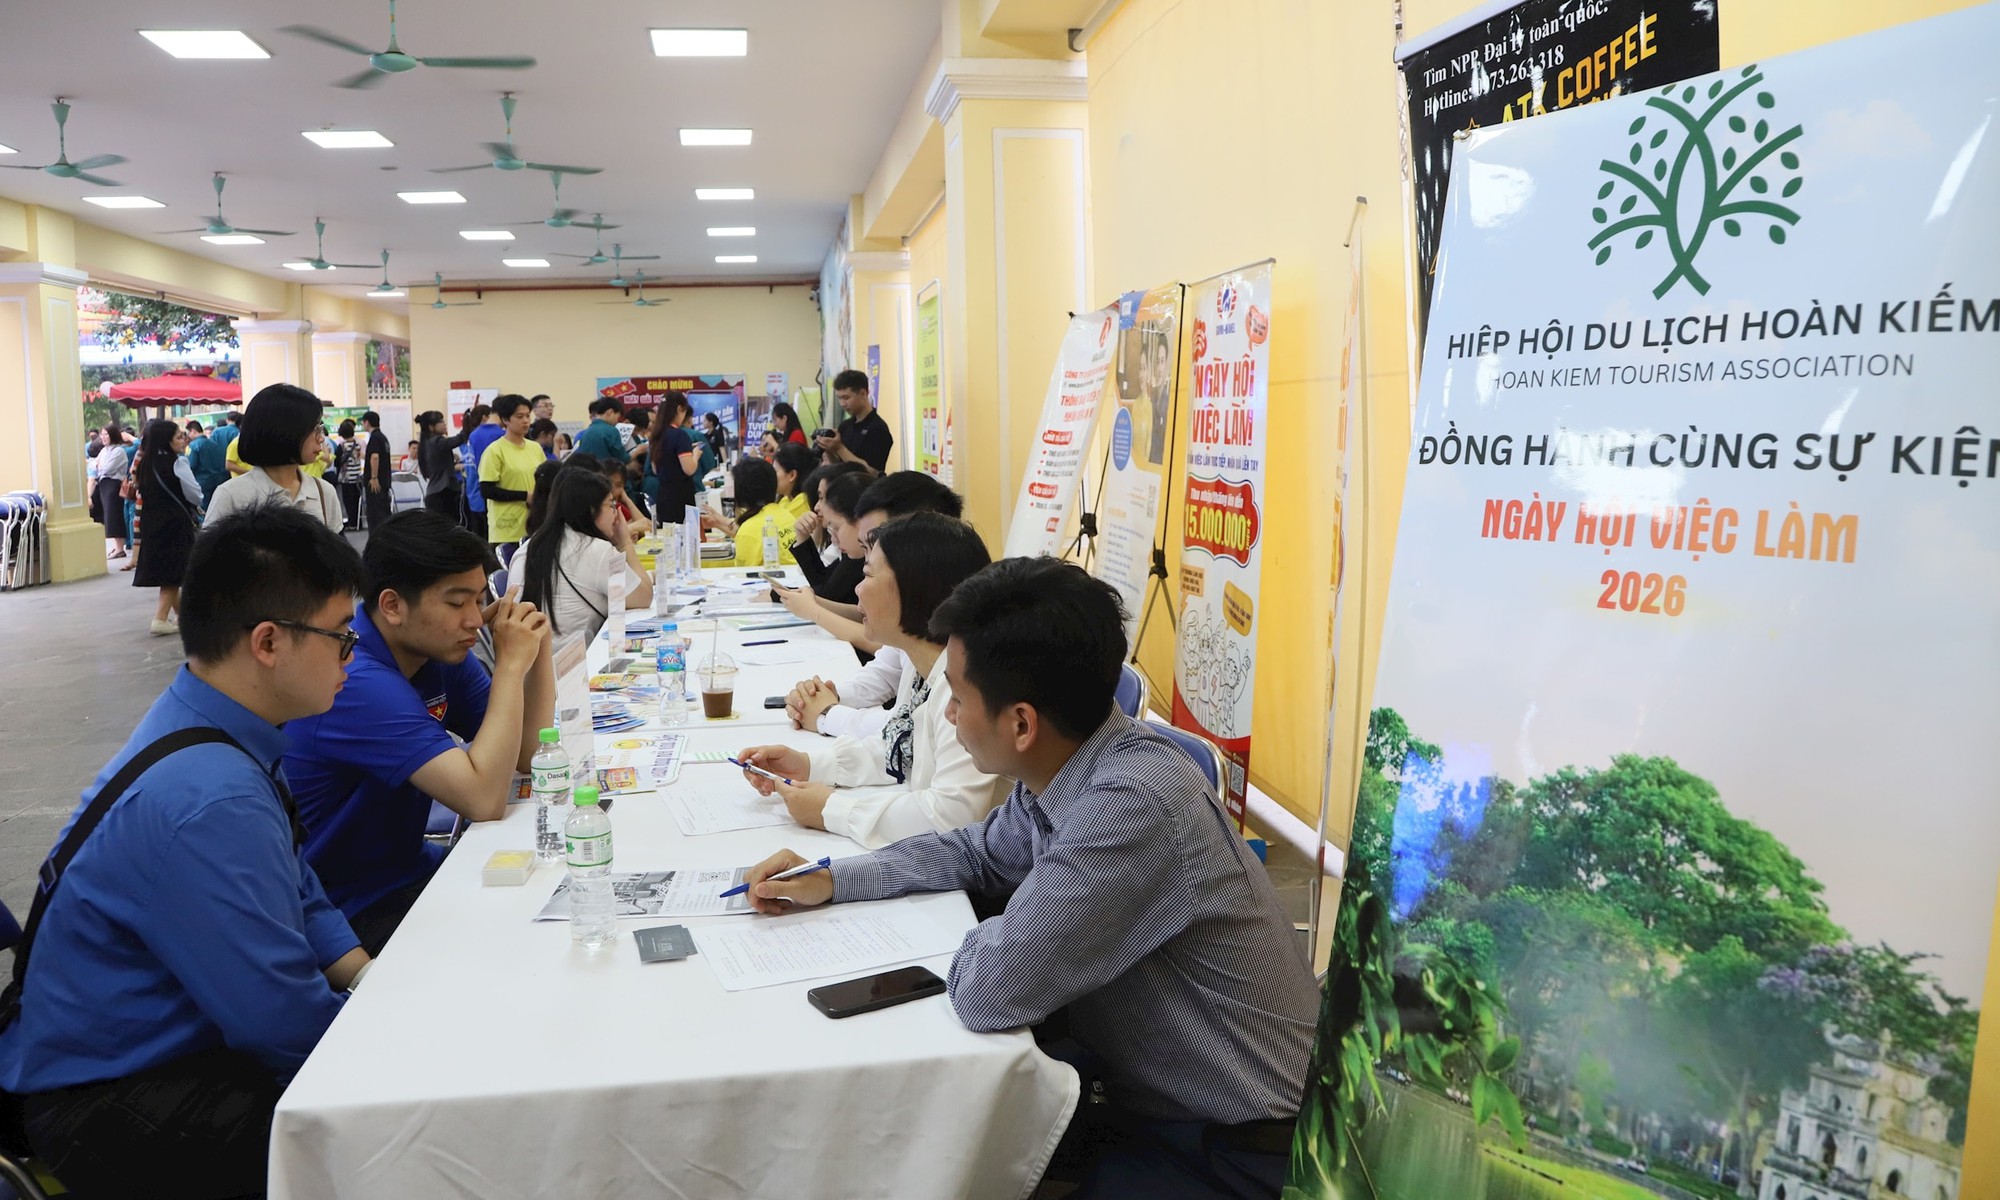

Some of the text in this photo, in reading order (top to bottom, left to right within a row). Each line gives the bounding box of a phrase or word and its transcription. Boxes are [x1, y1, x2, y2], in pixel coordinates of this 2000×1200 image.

[1423, 68, 1447, 89] Tìm
[1483, 39, 1508, 65] Đại
[1529, 17, 1559, 44] toàn
[1557, 13, 1658, 108] COFFEE
[1518, 320, 1574, 361] HỘI
[1583, 321, 1632, 351] DU
[1642, 314, 1728, 350] LỊCH
[1740, 299, 1863, 341] HOÀN
[1878, 282, 2000, 334] KIẾM
[1194, 353, 1255, 404] NGÀY HỘI
[1550, 366, 1602, 388] KIEM
[1608, 361, 1714, 386] TOURISM
[1722, 354, 1915, 380] ASSOCIATION
[1193, 403, 1220, 450] VIỆC
[1419, 421, 1513, 466] ĐỒNG
[1648, 425, 1778, 469] CÙNG
[1793, 431, 1876, 483] SỰ
[1481, 492, 1567, 542] NGÀY
[1649, 498, 1739, 562] VIỆC
[1754, 501, 1859, 564] LÀM
[1597, 569, 1687, 617] 2026
